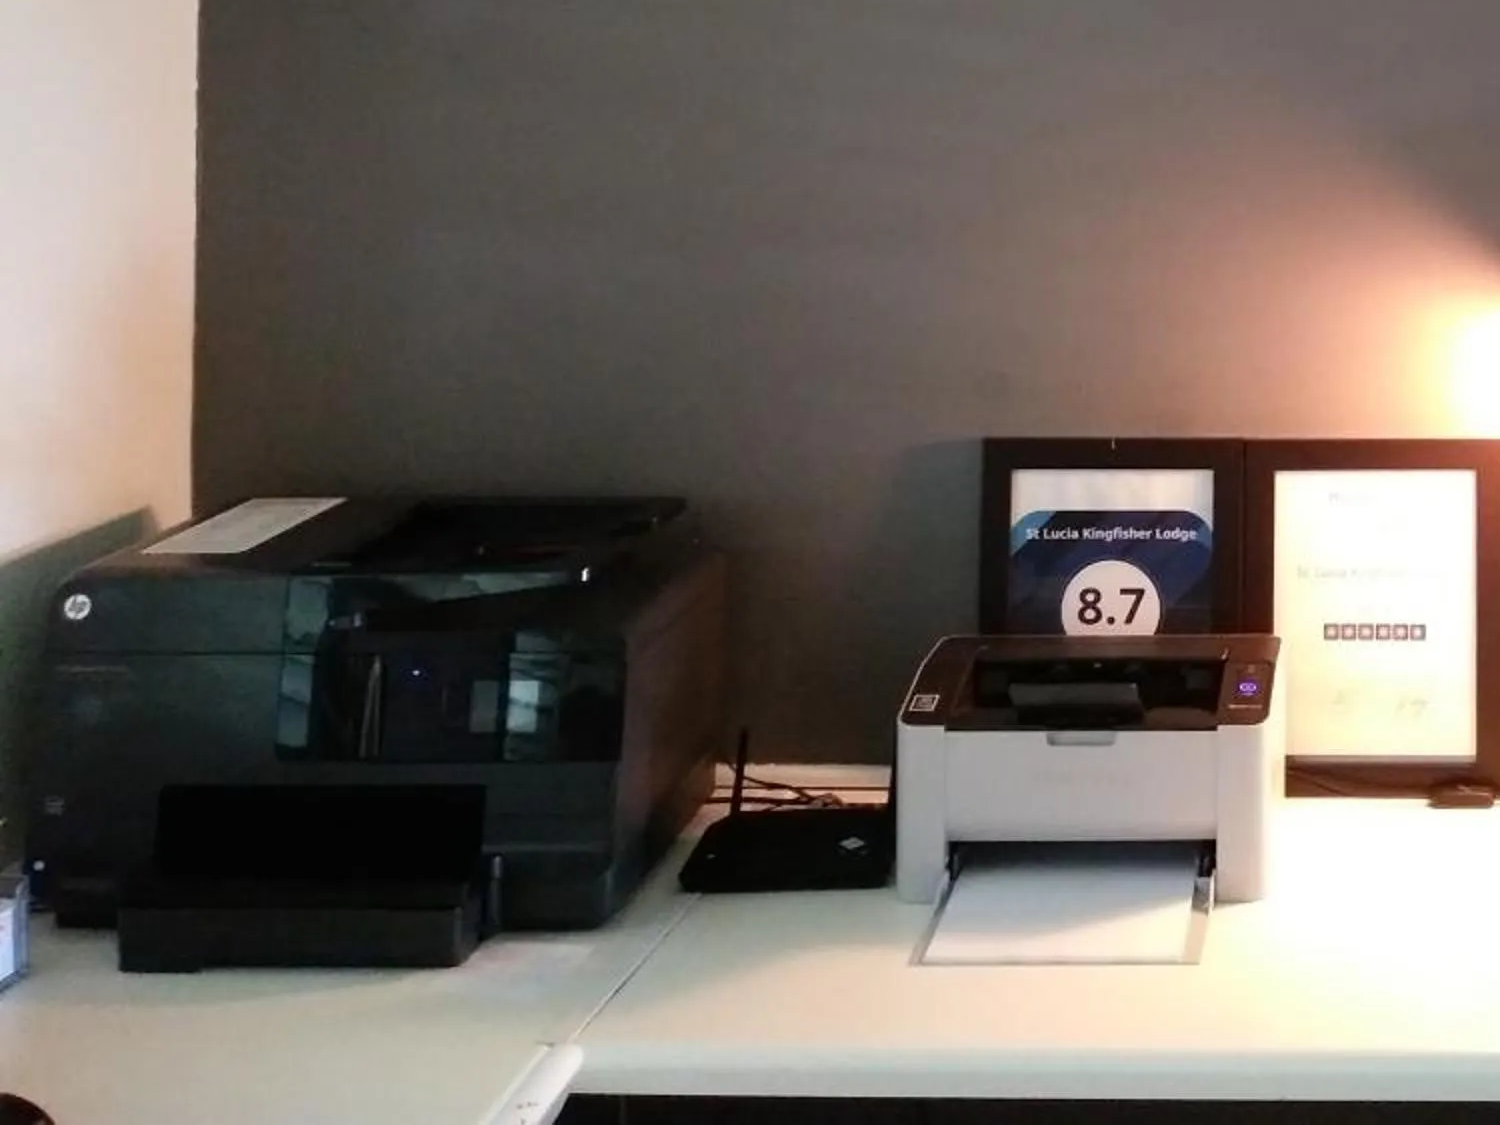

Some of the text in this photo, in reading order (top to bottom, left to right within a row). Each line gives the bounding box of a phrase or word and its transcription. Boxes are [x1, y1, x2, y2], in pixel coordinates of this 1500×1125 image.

[1025, 526, 1197, 543] St Lucia Kingfisher Lodge
[1077, 587, 1146, 626] 8.7
